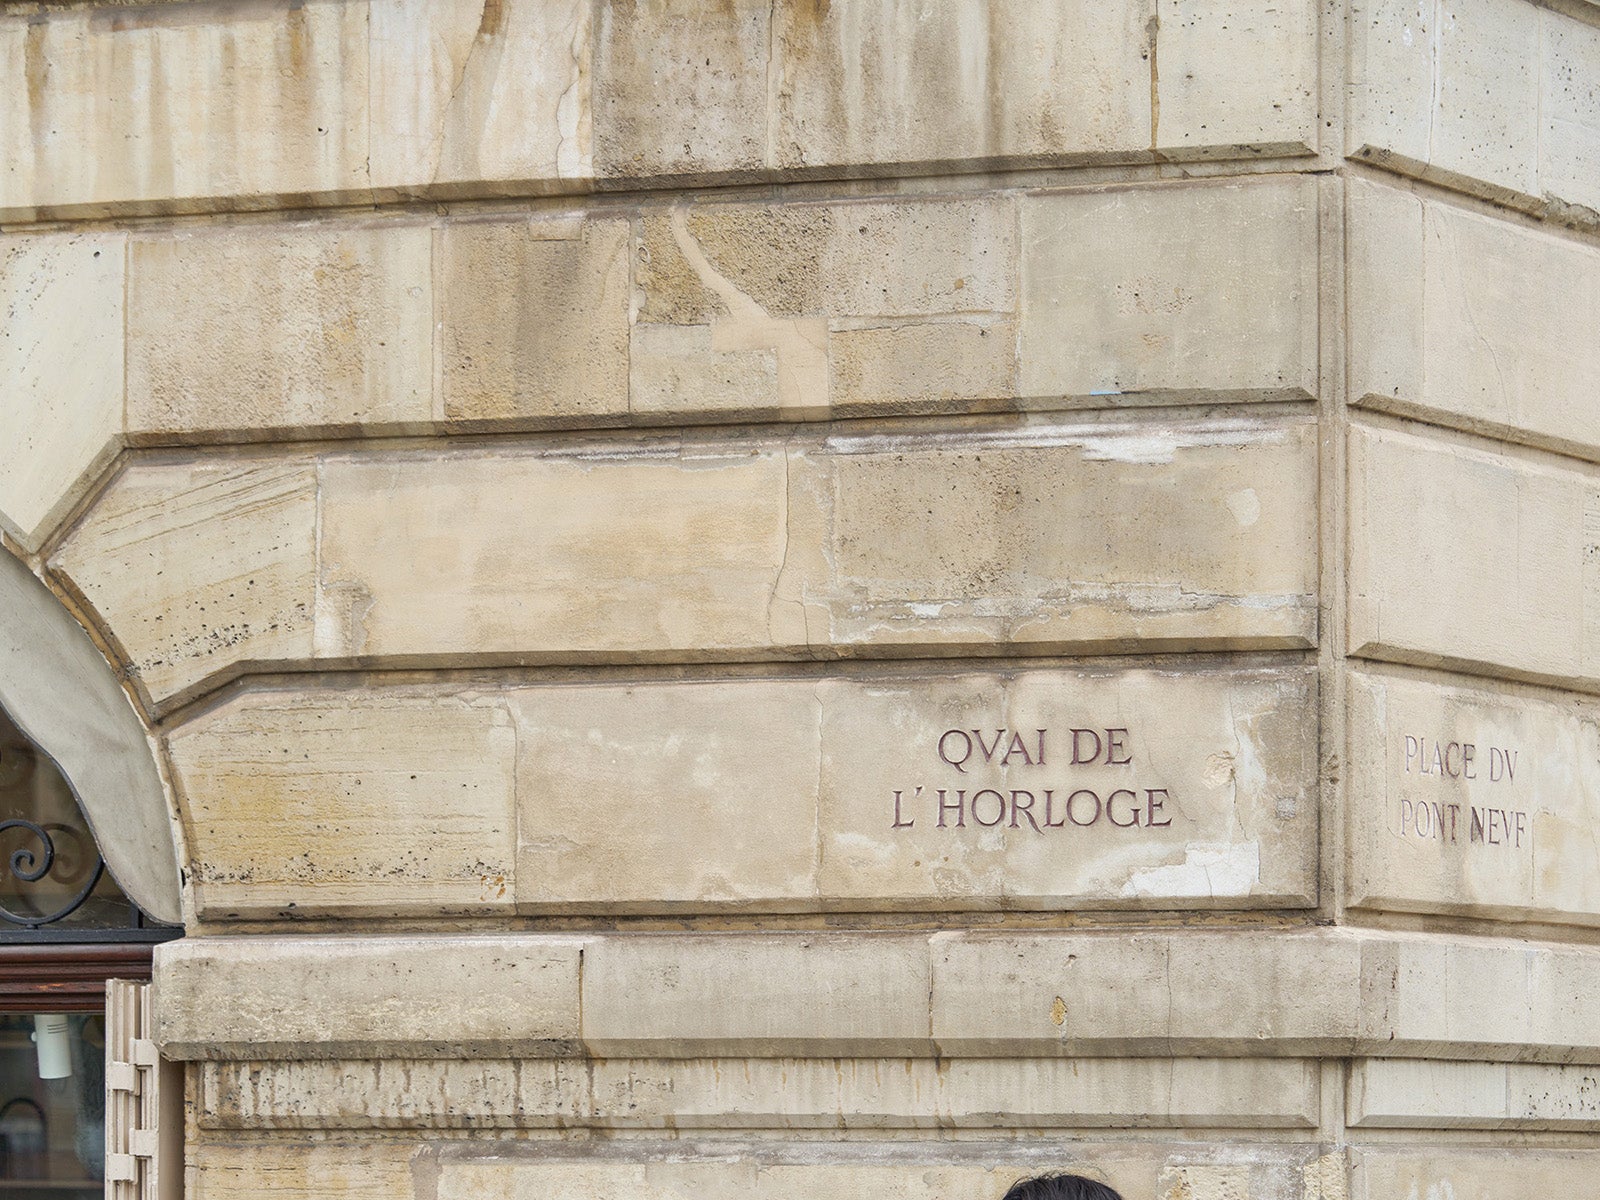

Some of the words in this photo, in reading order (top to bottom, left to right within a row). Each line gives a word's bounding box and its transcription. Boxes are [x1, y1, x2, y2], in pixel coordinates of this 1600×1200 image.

[937, 728, 1047, 774] QVAI
[1069, 728, 1133, 766] DE
[1405, 735, 1477, 779] PLACE
[1489, 747, 1518, 785] DV
[1400, 799, 1460, 842] PONT
[1470, 806, 1526, 848] NEVF
